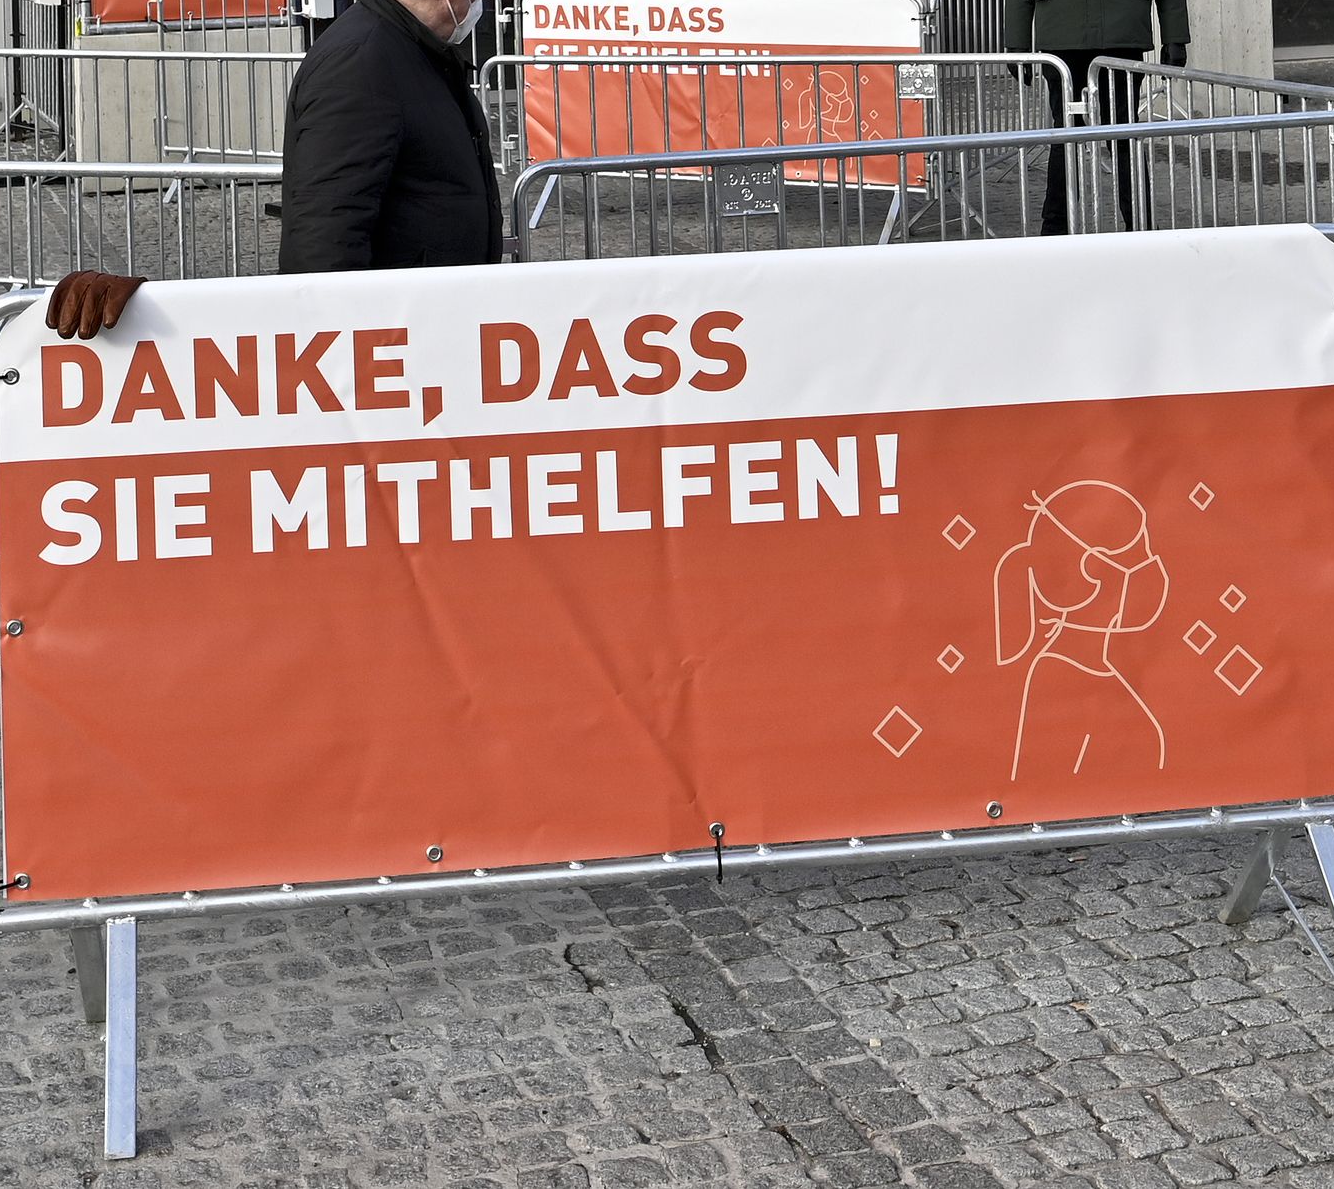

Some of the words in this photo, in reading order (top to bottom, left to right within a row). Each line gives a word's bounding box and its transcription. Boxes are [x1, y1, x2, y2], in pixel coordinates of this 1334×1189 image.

[534, 5, 639, 36] DANKE,
[648, 7, 725, 33] DASS
[41, 327, 443, 427] DANKE,
[479, 310, 748, 405] DASS
[38, 473, 213, 565] SIE
[251, 433, 900, 554] MITHELFEN!
